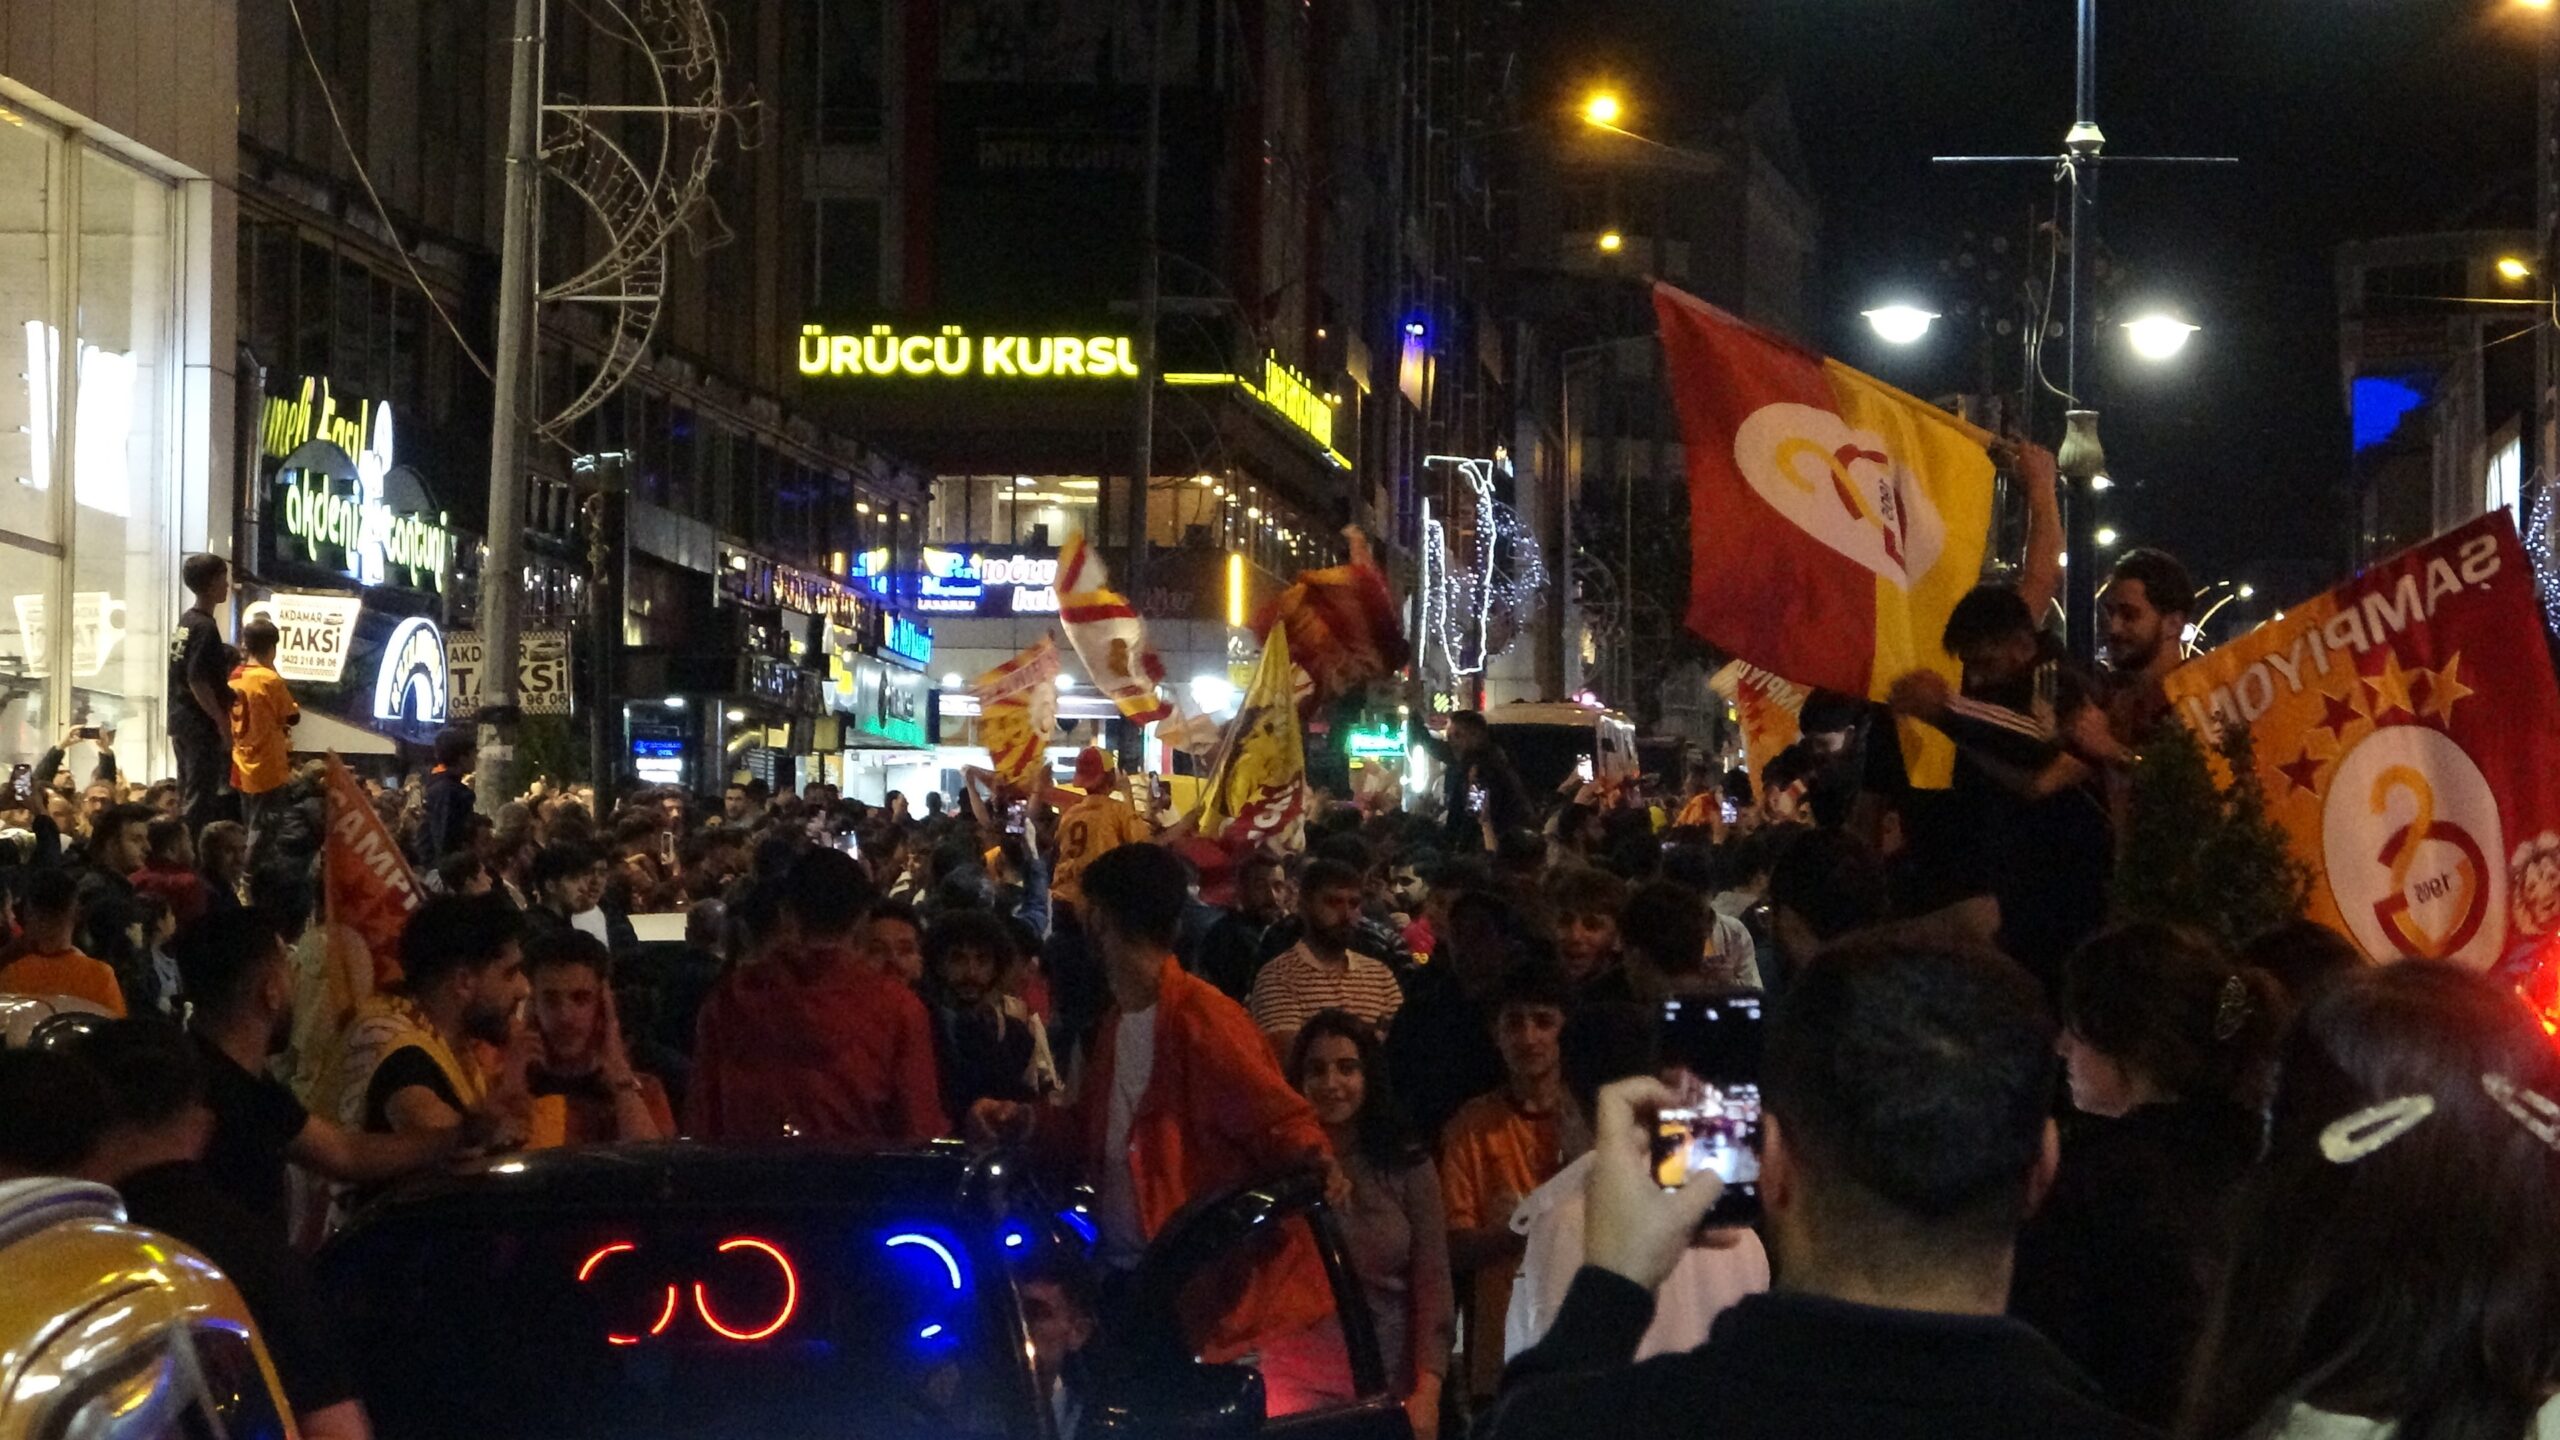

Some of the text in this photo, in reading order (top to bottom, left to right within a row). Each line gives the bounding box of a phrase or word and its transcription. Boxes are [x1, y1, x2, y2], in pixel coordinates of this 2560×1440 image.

[279, 610, 322, 623] AKDAMAR
[549, 692, 567, 706] 06
[1068, 820, 1088, 858] 9
